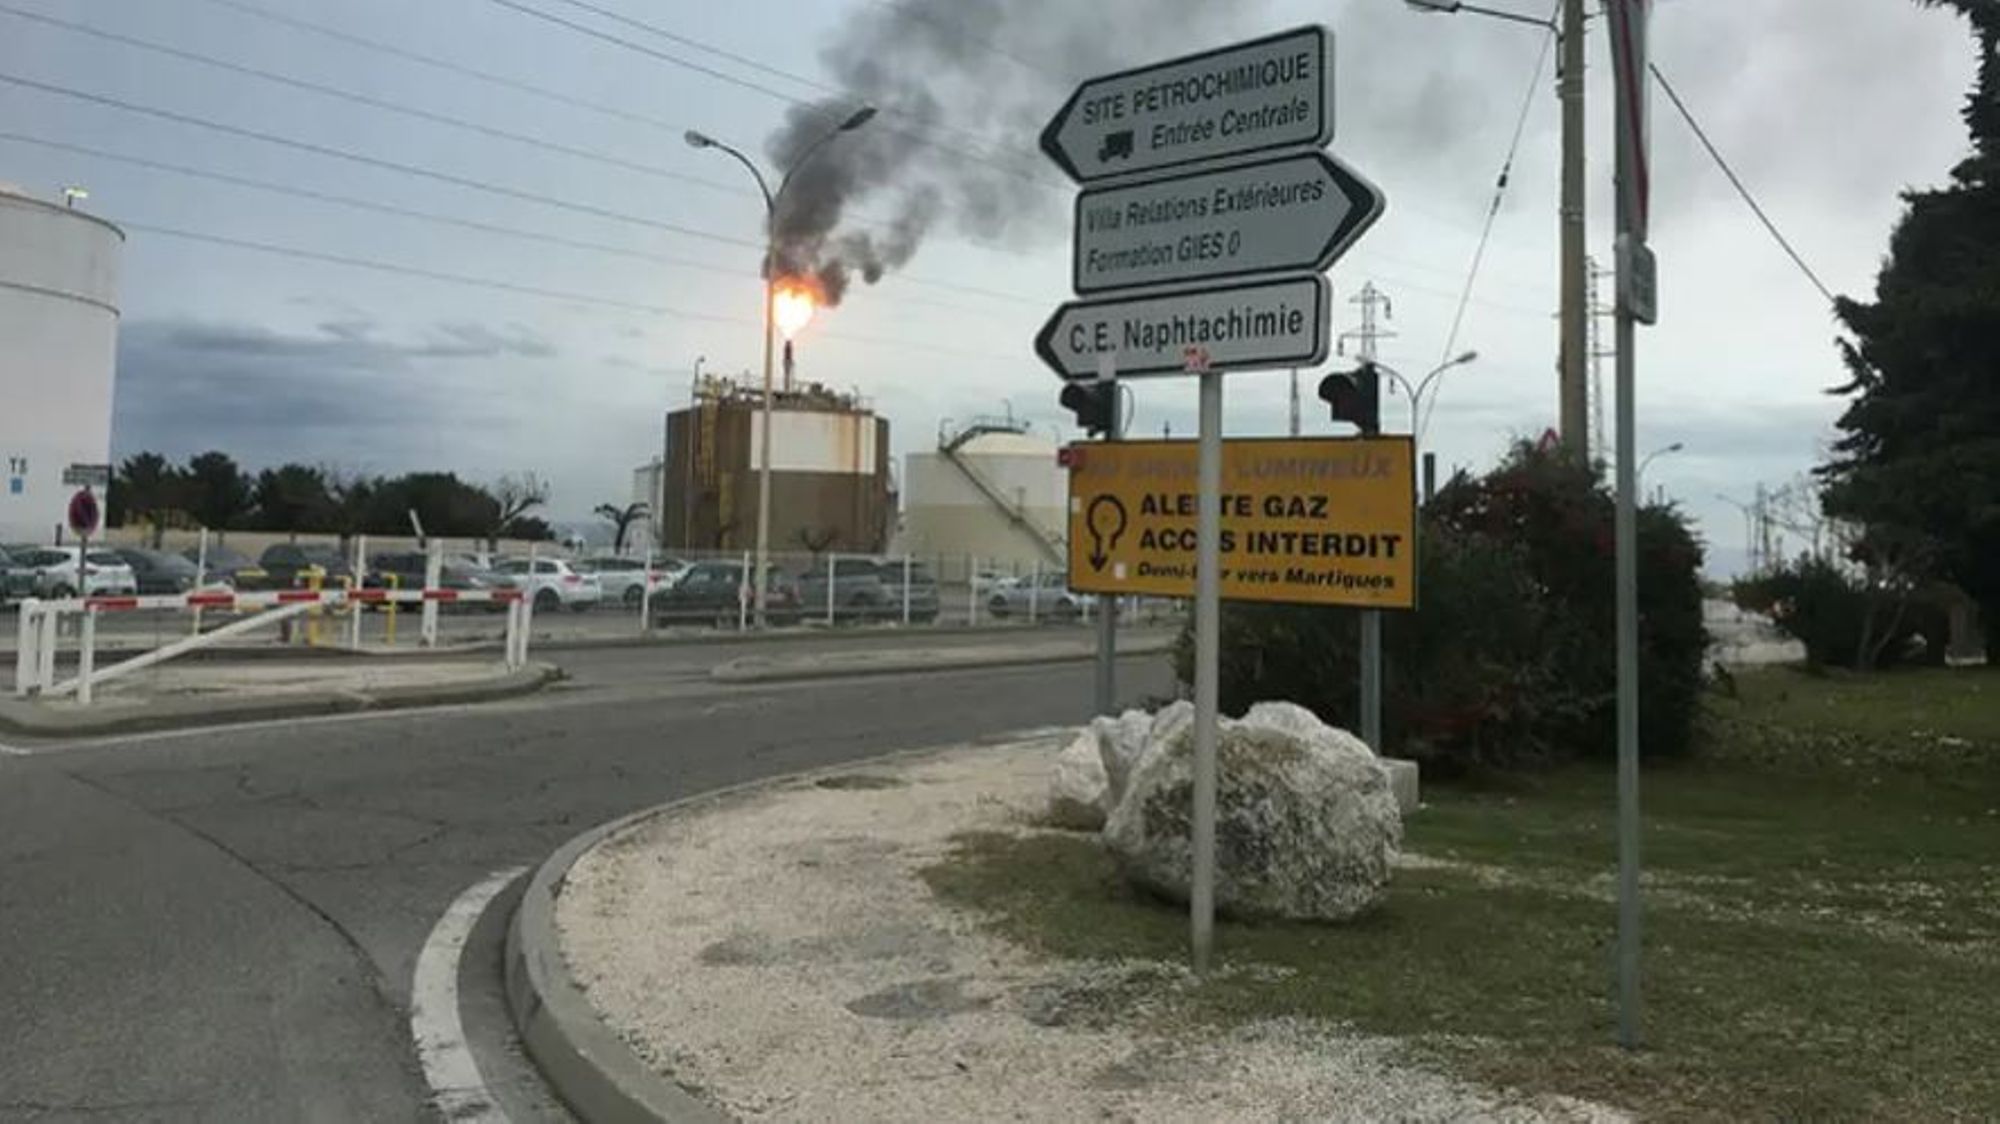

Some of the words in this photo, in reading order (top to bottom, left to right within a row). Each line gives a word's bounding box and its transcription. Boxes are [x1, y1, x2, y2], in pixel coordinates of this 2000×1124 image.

[1083, 93, 1125, 126] SITE
[1133, 52, 1311, 114] PÉTROCHIMIQUE
[1151, 118, 1216, 150] Entrée
[1220, 96, 1310, 136] Centrale
[1087, 209, 1122, 233] Villa
[1126, 193, 1209, 227] Relations
[1214, 178, 1325, 216] Extérieures
[1086, 243, 1174, 273] Formation
[1176, 231, 1226, 262] GIES
[1070, 322, 1117, 354] C.E.
[1123, 306, 1304, 353] Naphtachimie
[1140, 493, 1253, 517] ALETE
[1263, 495, 1328, 519] GAZ
[1138, 527, 1236, 553] ACCS
[1245, 531, 1402, 558] INTERDIT
[1236, 568, 1280, 584] vers
[1284, 566, 1396, 592] Martigues
